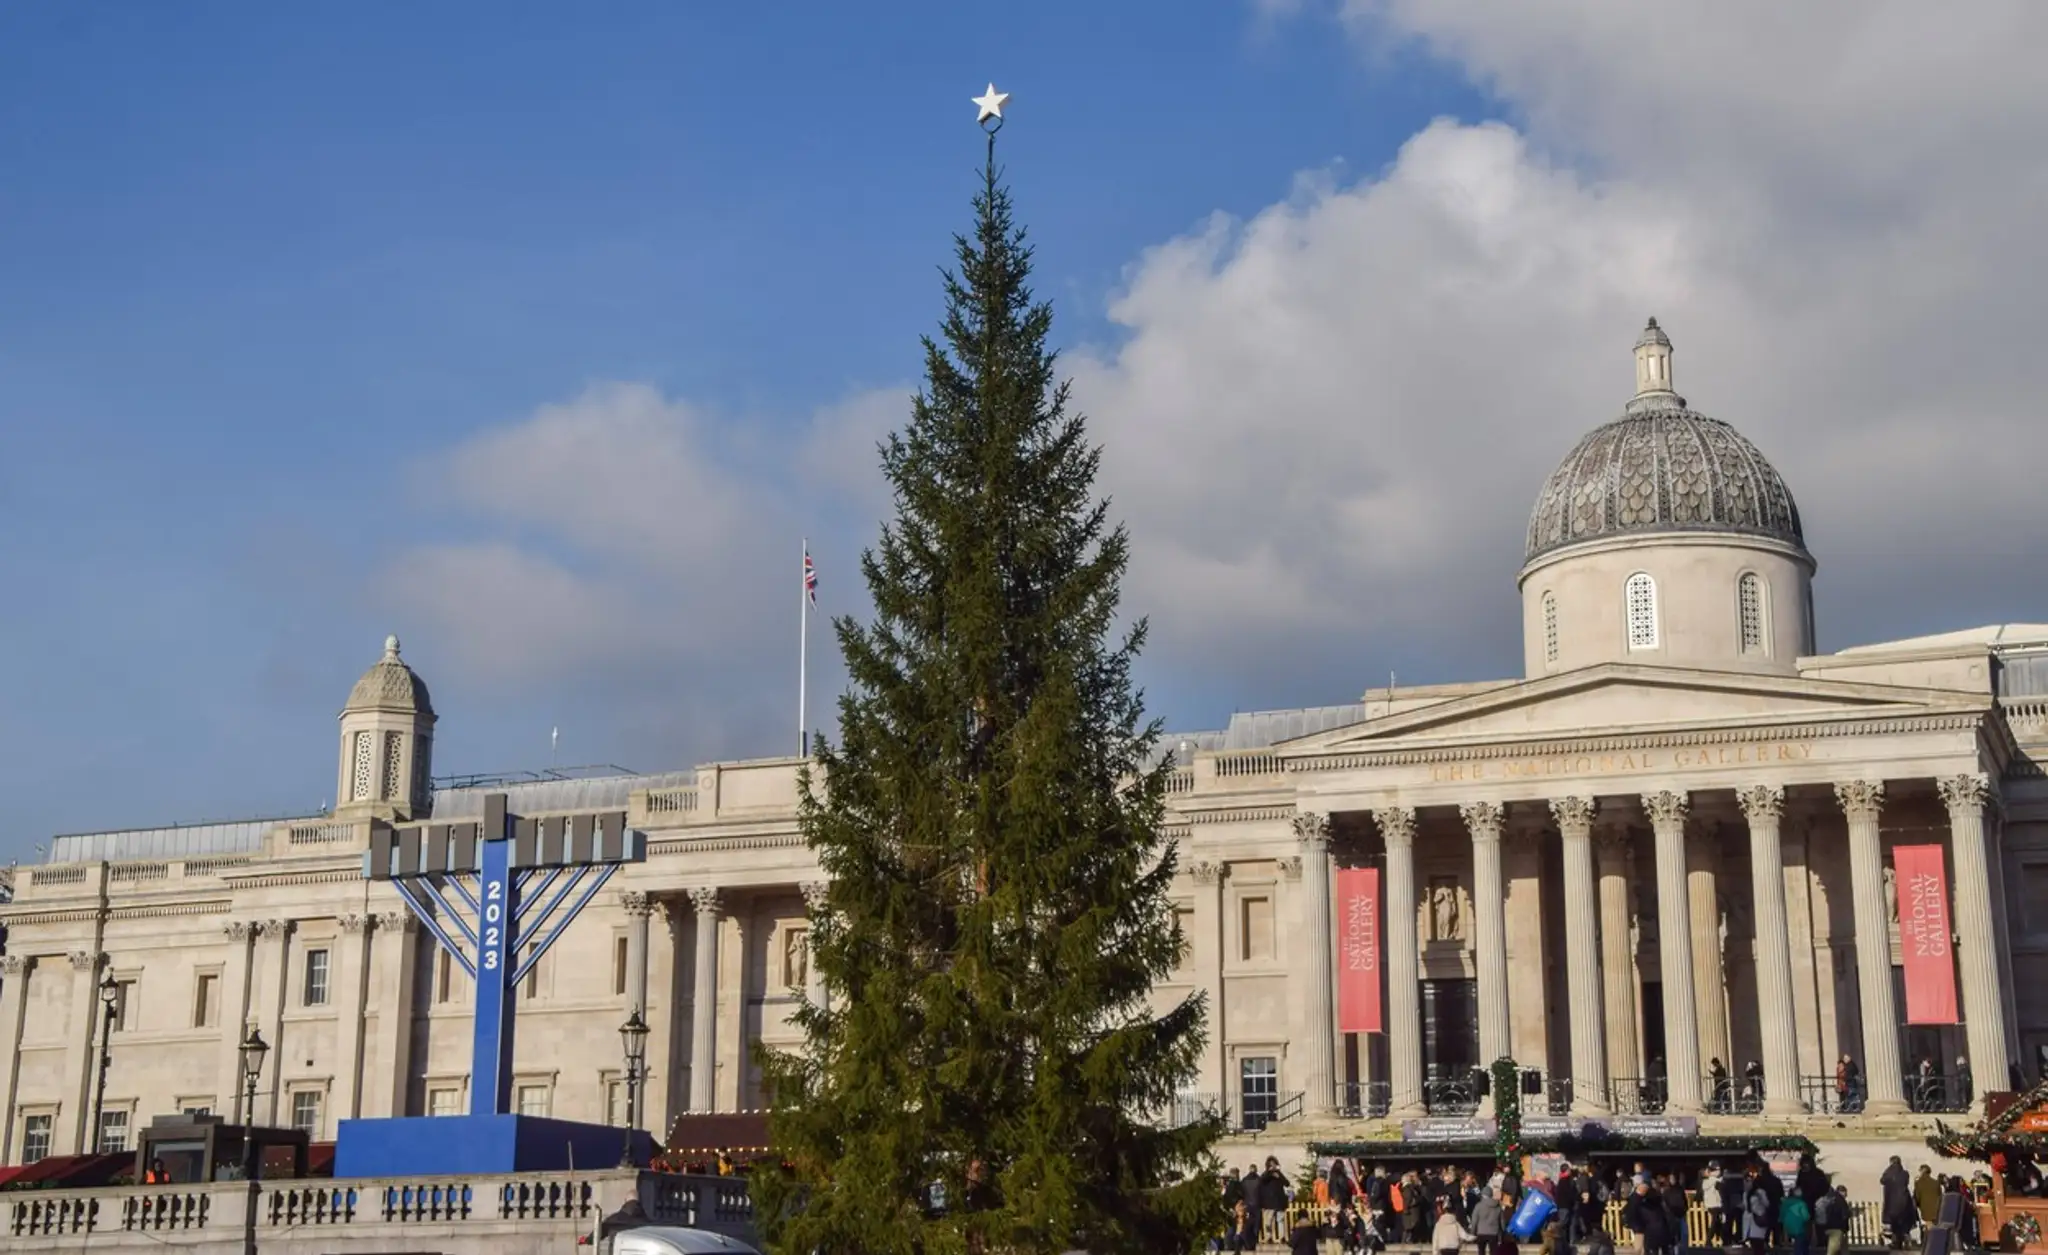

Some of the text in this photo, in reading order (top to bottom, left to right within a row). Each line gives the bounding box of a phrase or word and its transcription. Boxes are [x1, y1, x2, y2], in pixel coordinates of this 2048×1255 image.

[1428, 743, 1812, 781] THE NATIONAL GALLERY
[484, 880, 501, 970] 2023
[1349, 895, 1360, 970] NATIONAL
[1361, 894, 1374, 970] GALLERY
[1909, 873, 1930, 956] NATIONAL
[1923, 874, 1945, 956] GALLERY
